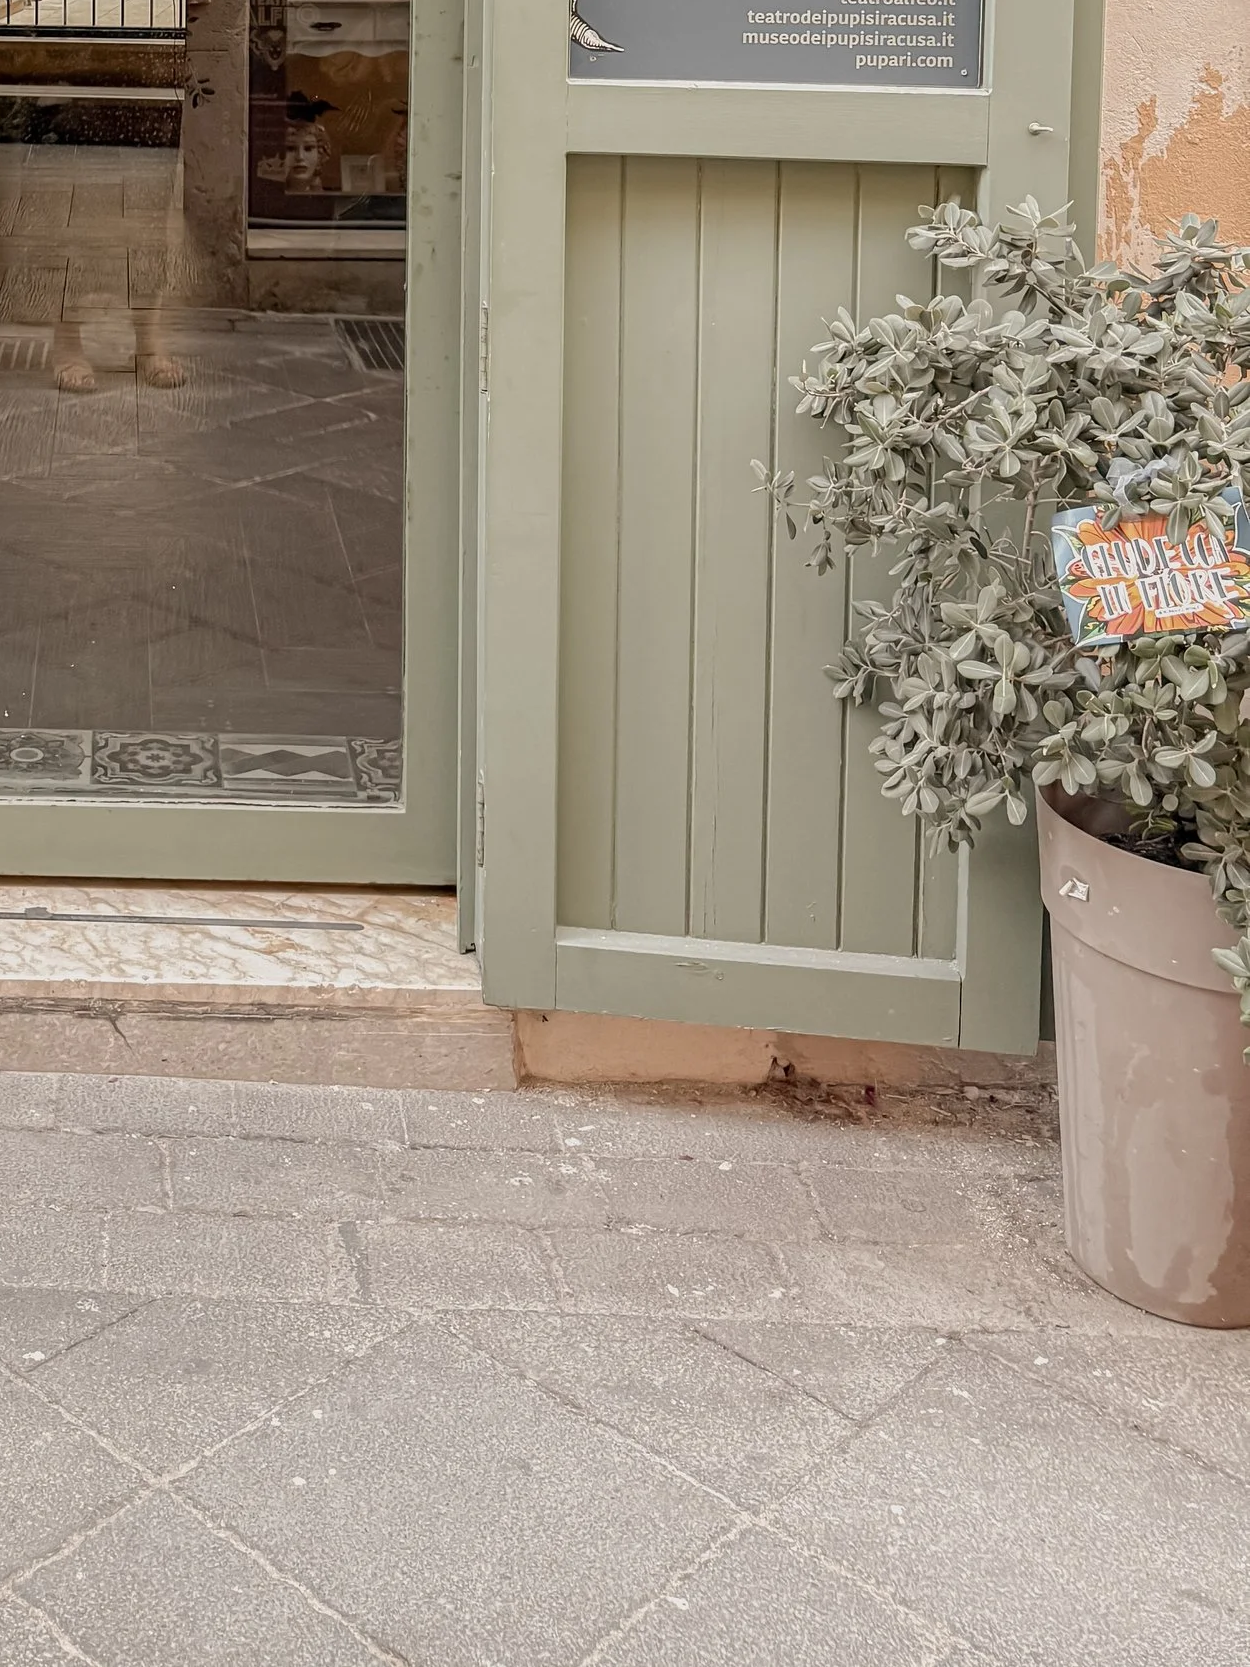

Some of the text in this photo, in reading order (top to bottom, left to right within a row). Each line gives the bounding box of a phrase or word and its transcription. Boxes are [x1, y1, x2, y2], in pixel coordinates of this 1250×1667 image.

[746, 10, 956, 28] teatrodeipupisiracusa.it
[742, 30, 954, 48] museodeipupisiracusa.it
[855, 53, 953, 70] pupari.com
[1135, 567, 1239, 610] FIORE
